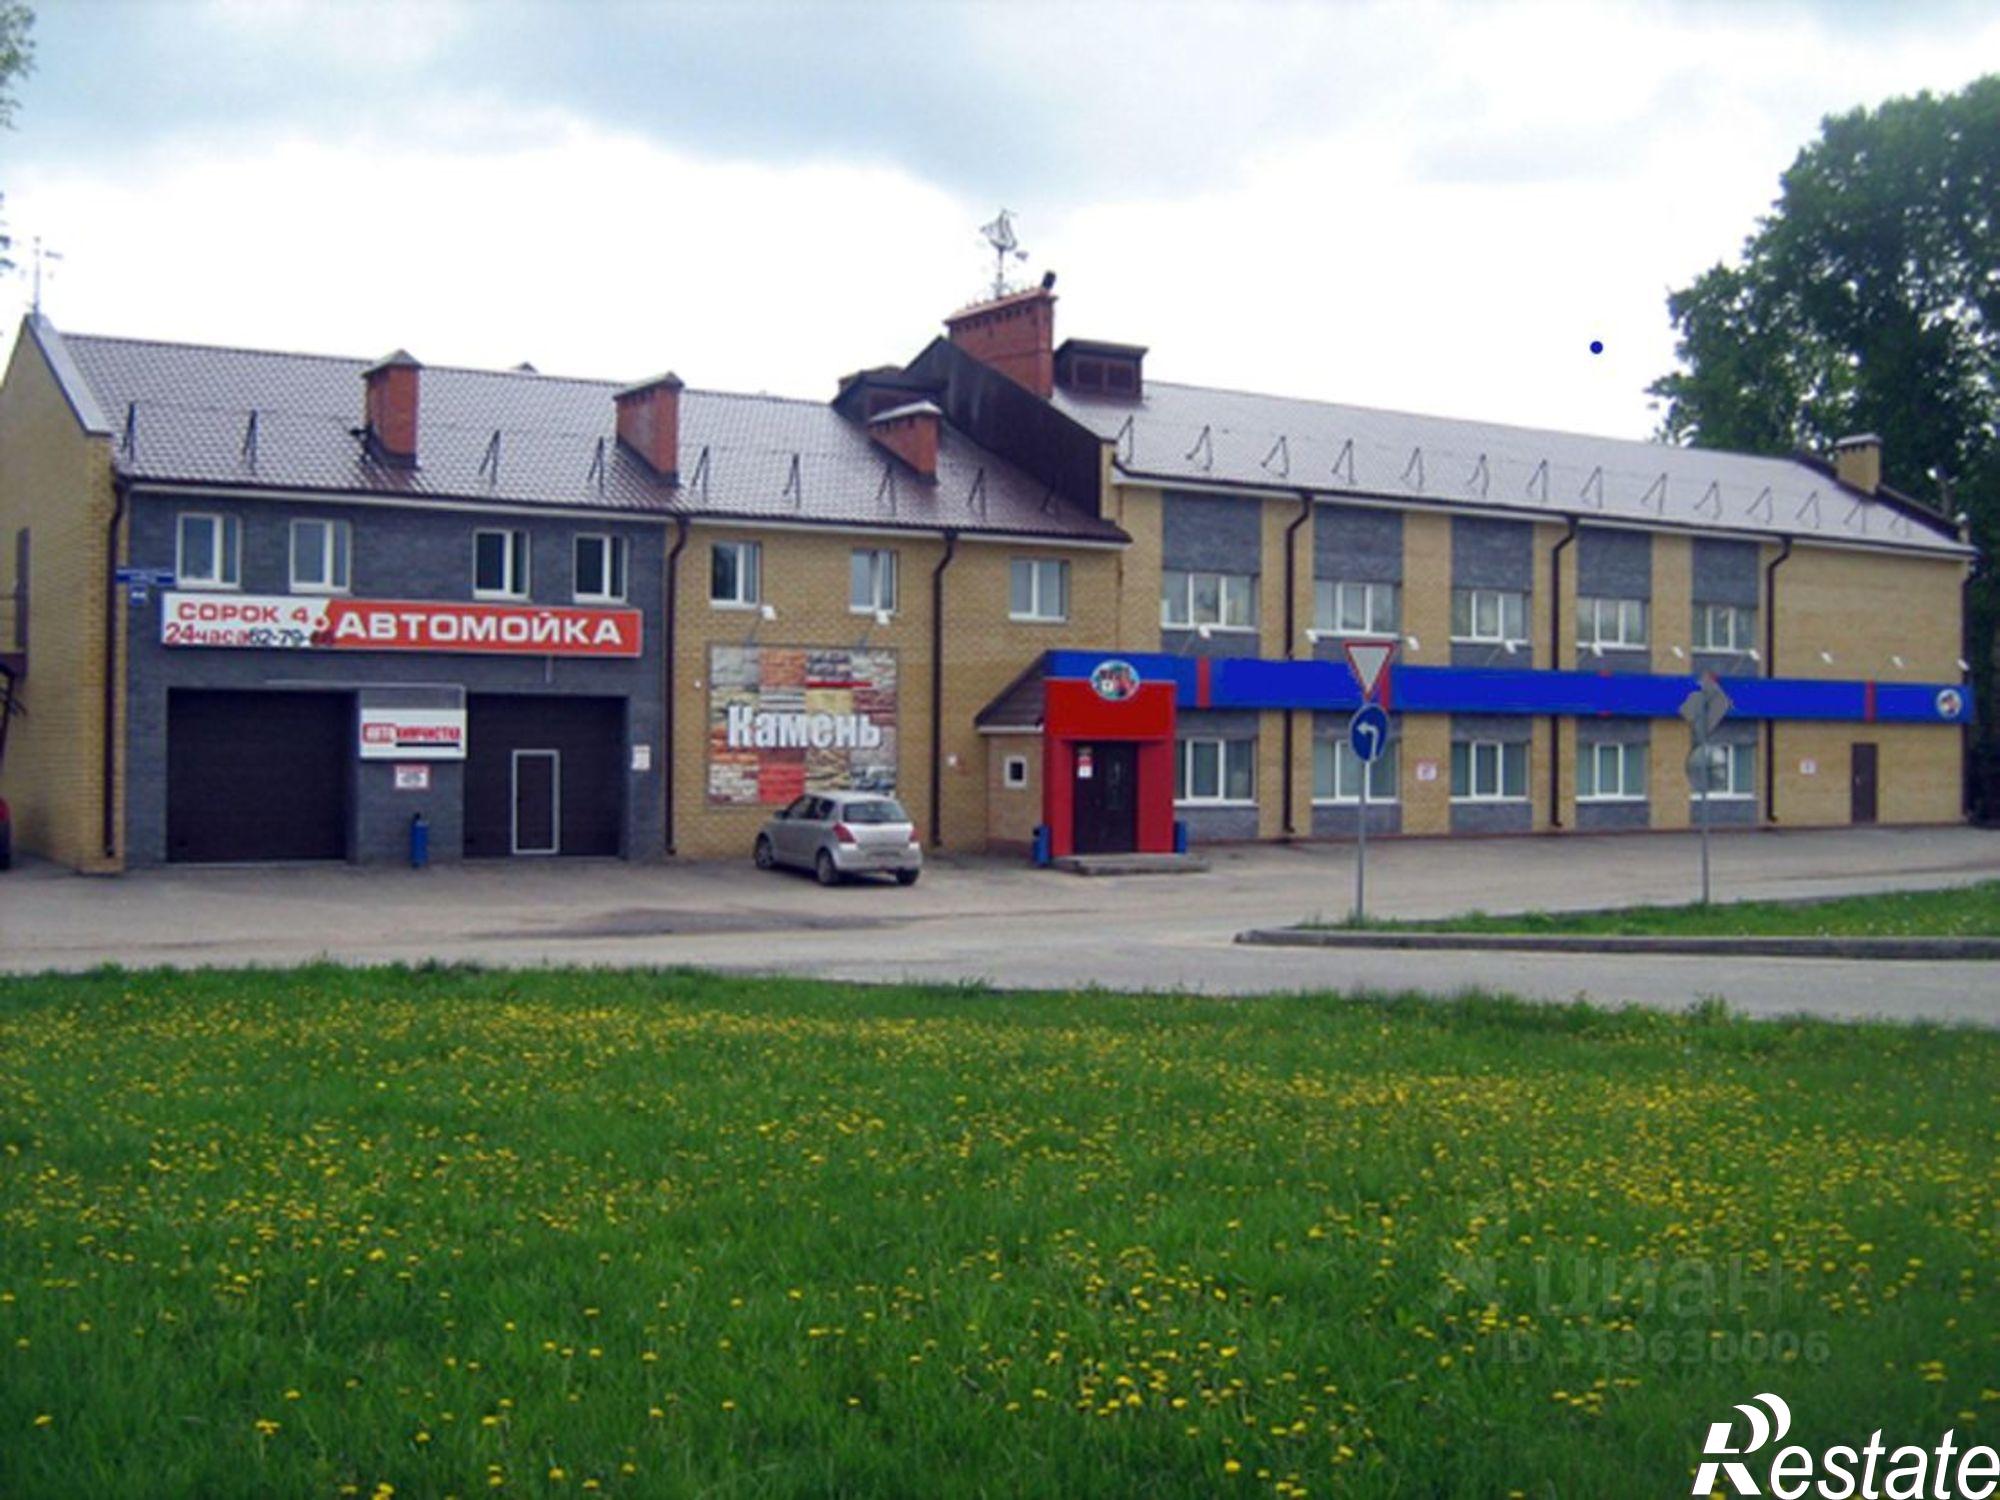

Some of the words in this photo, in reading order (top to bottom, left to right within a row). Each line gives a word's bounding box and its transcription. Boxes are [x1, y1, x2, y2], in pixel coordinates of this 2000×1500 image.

[177, 602, 279, 623] СОРОК
[335, 602, 622, 645] АВТОМОЙКА
[727, 704, 882, 749] Камень
